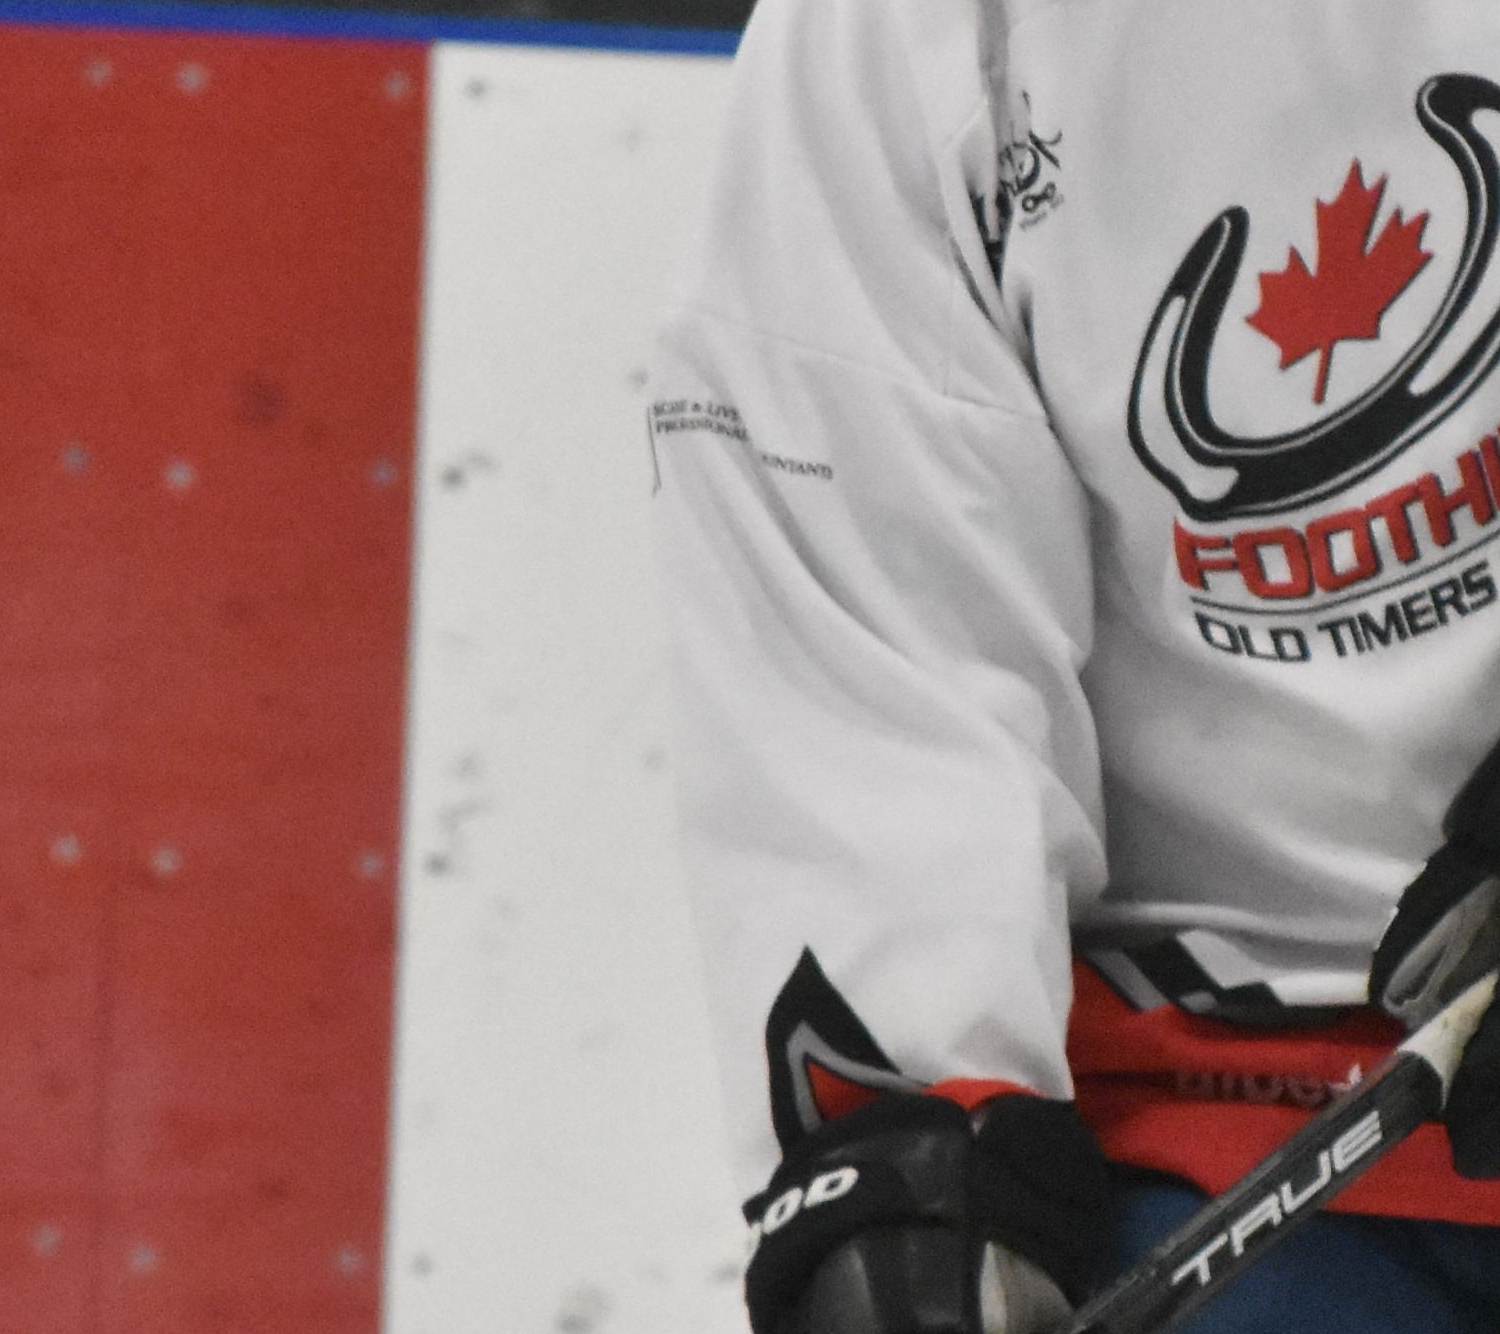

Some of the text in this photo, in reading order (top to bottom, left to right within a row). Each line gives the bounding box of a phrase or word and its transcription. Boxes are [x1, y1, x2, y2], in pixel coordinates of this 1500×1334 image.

[1195, 610, 1310, 663] OLD
[1316, 566, 1498, 659] TIMERS
[1171, 1109, 1382, 1287] TRUE
